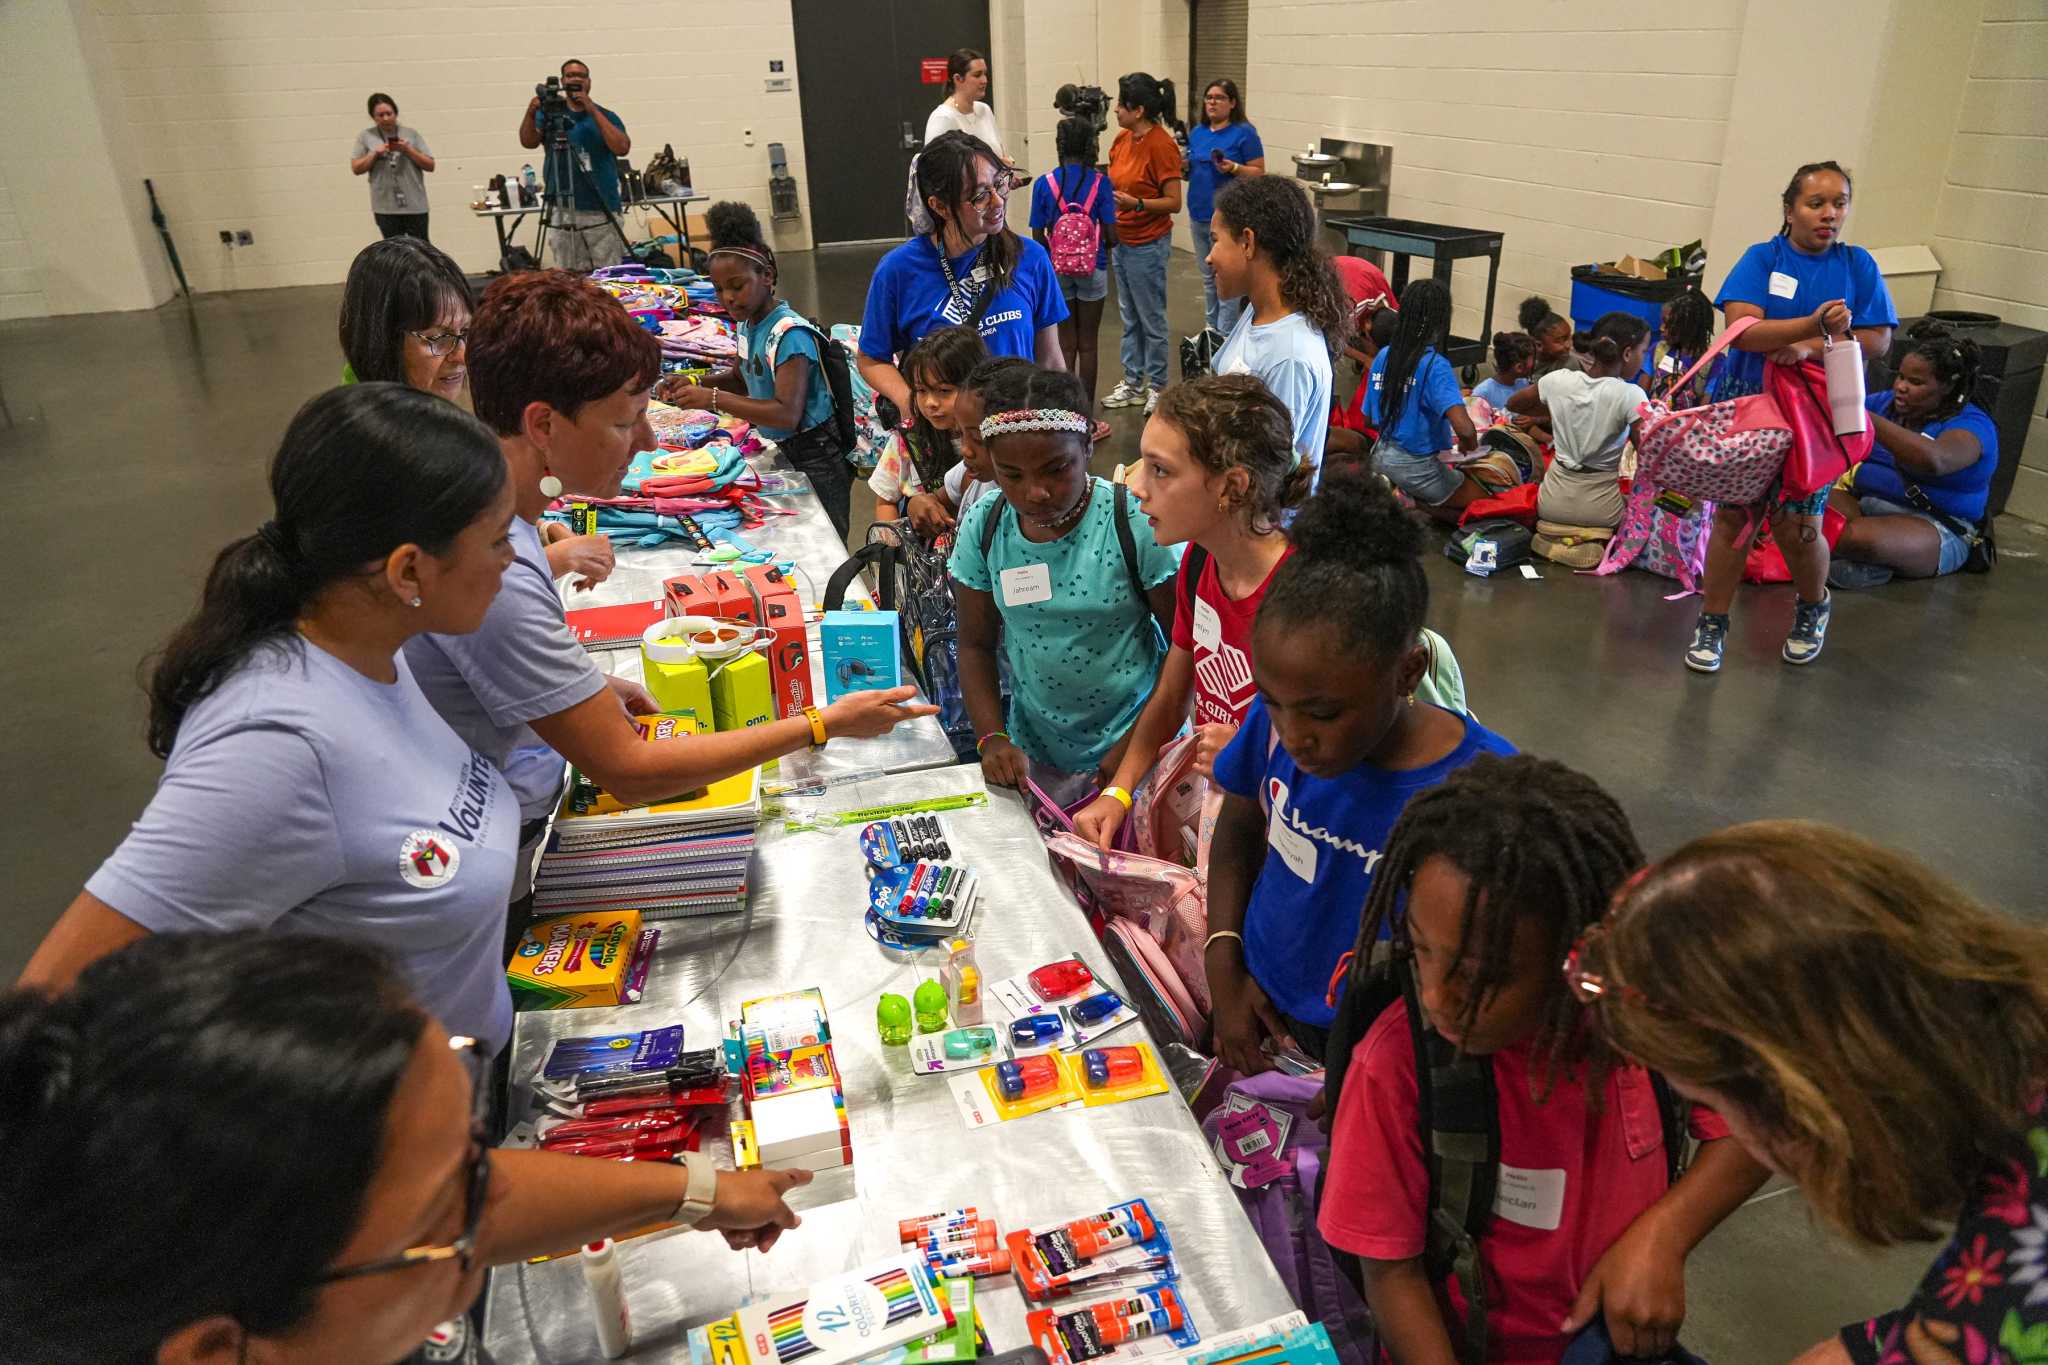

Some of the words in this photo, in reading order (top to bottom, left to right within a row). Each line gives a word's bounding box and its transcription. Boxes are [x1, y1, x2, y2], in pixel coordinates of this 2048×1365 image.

[985, 309, 1022, 326] CLUBS
[981, 327, 997, 337] AREA
[746, 714, 769, 727] onn.
[1205, 700, 1240, 729] GIRLS
[656, 719, 675, 740] KERS
[437, 749, 490, 842] VOLUNTE
[1269, 777, 1384, 875] Champ
[602, 923, 626, 967] Crayola
[644, 929, 655, 941] 20
[524, 943, 539, 956] 20
[533, 923, 571, 976] MARKERS
[815, 1305, 850, 1333] 12
[713, 1320, 737, 1342] 12
